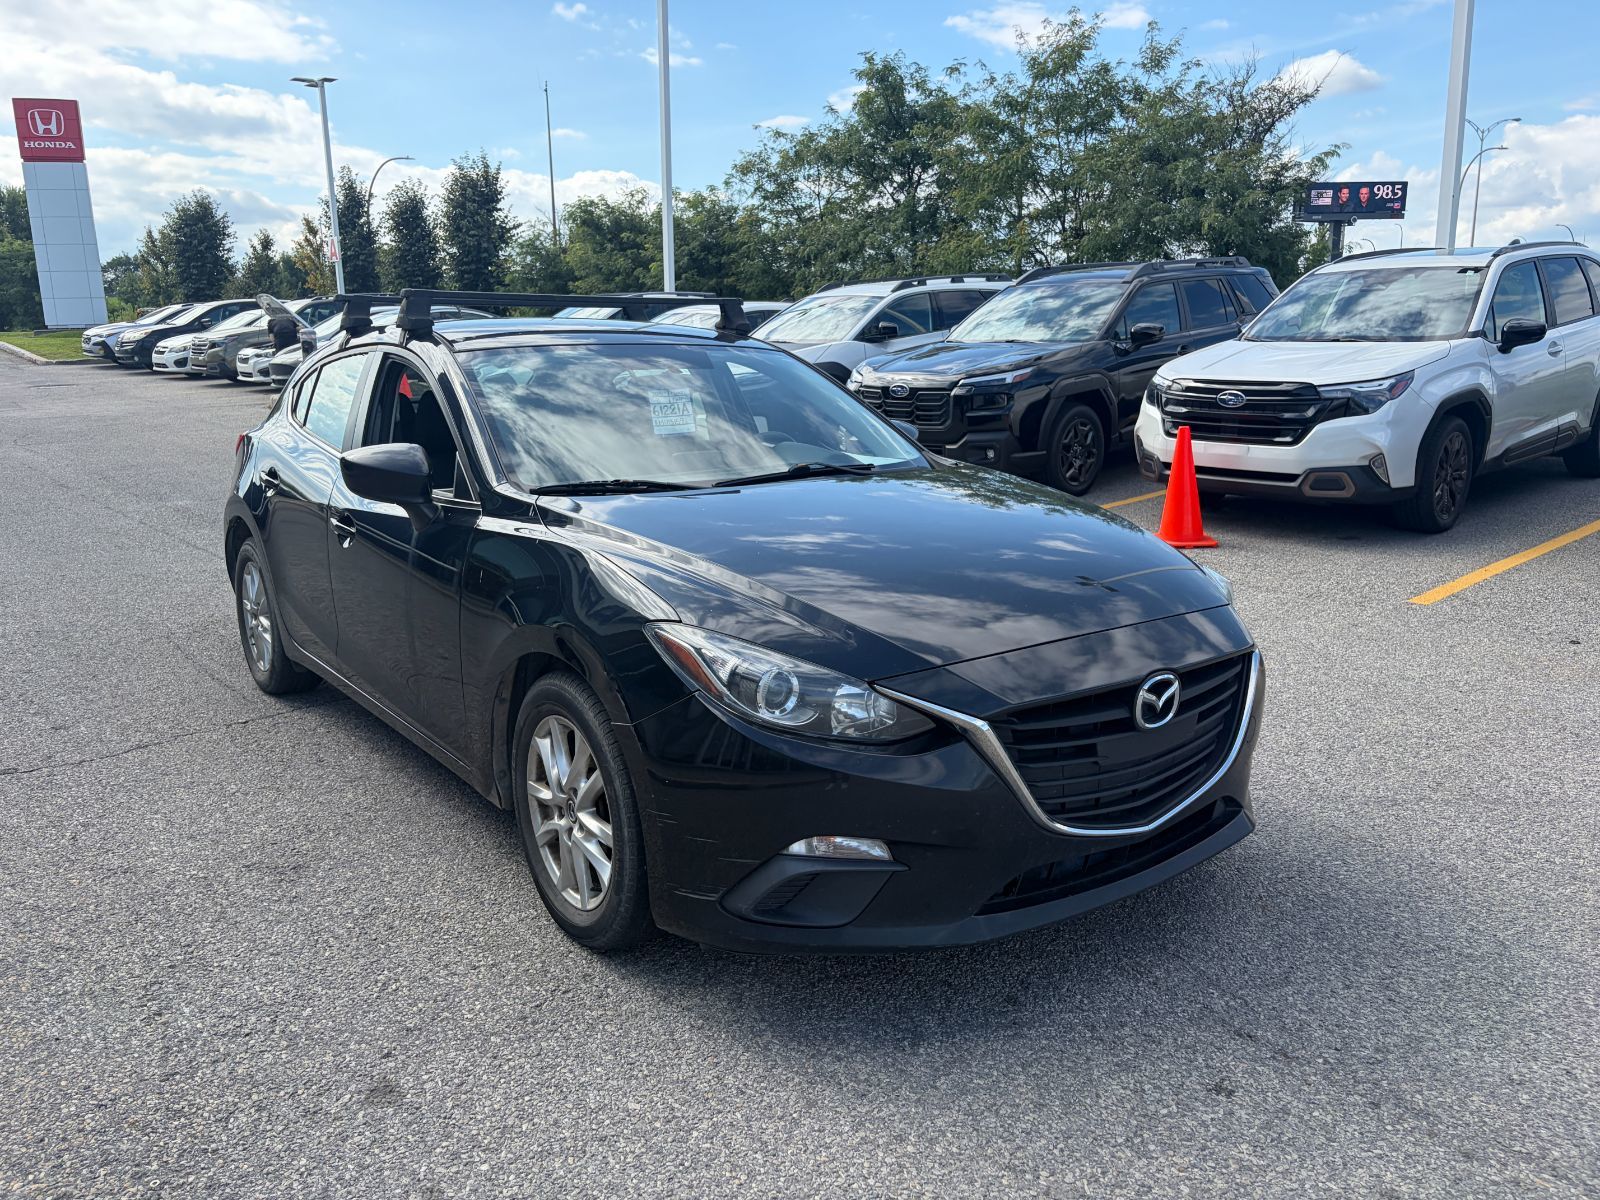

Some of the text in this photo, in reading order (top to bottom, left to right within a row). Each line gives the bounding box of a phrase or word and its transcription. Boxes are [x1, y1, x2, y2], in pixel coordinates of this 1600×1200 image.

[24, 141, 76, 149] HONDA
[1374, 185, 1402, 199] 98.5
[330, 239, 338, 260] A
